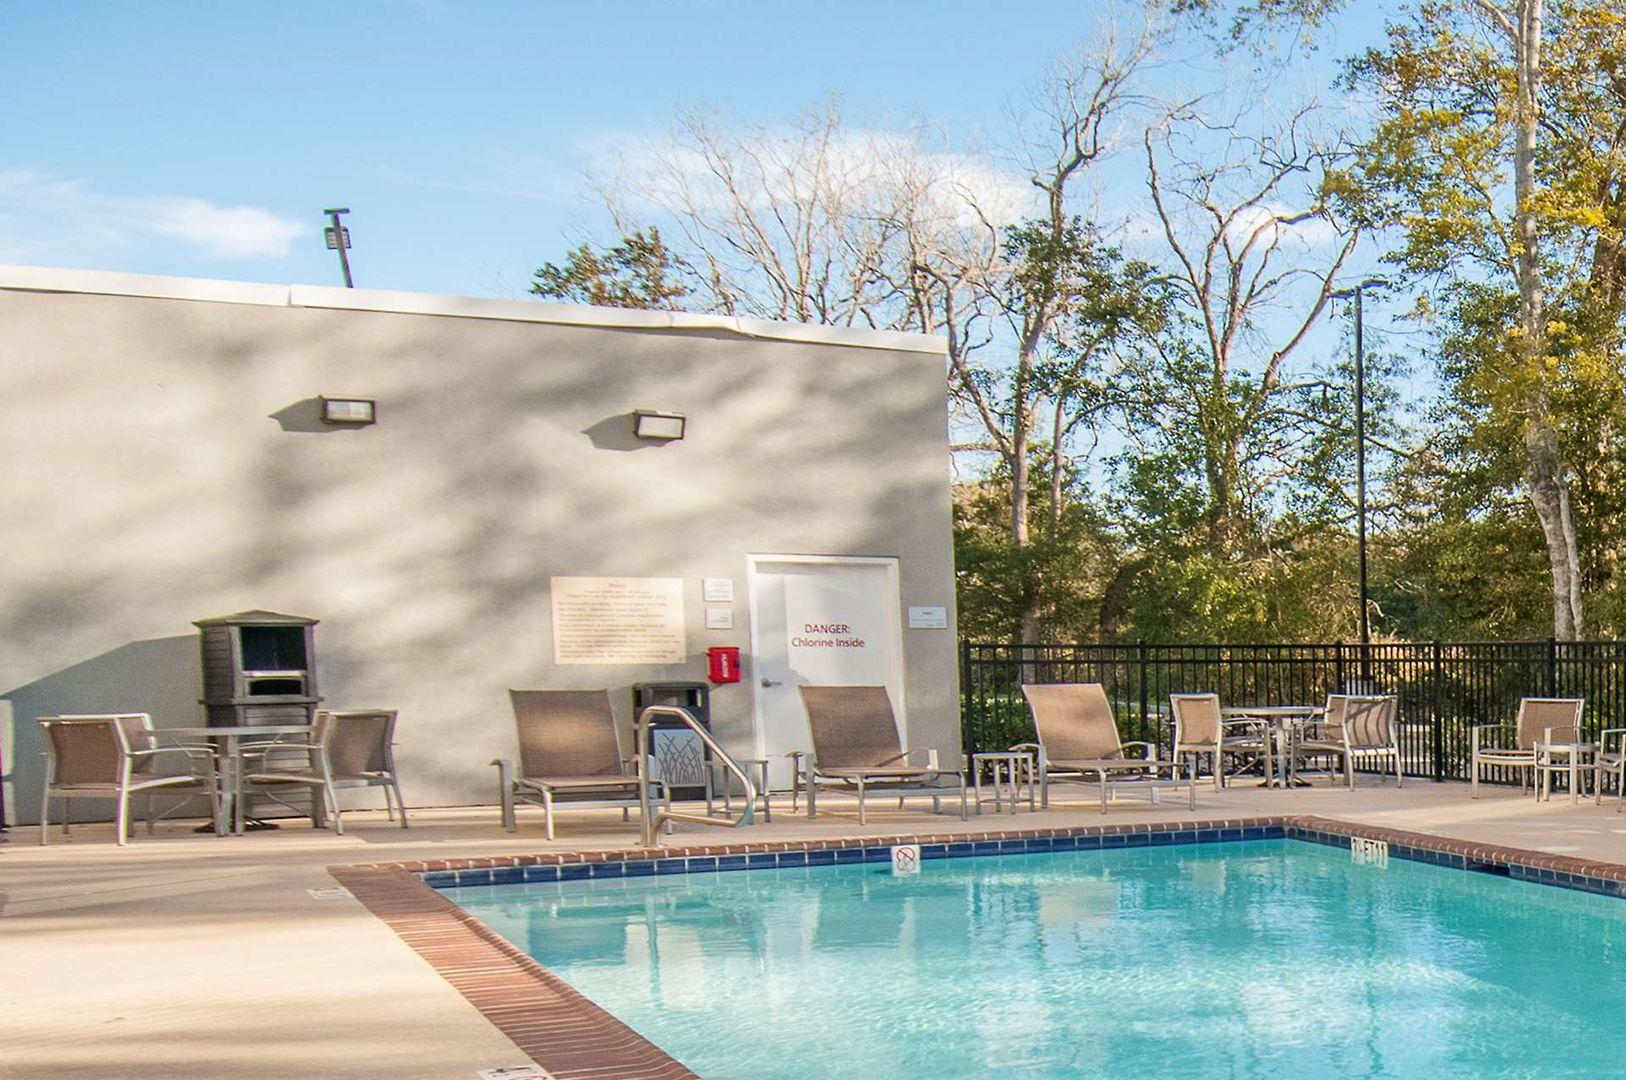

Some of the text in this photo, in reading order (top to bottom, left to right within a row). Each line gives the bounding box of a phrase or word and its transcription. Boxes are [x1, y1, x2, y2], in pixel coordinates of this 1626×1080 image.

[804, 623, 851, 634] DANGER:
[791, 637, 865, 648] Chlorine Inside
